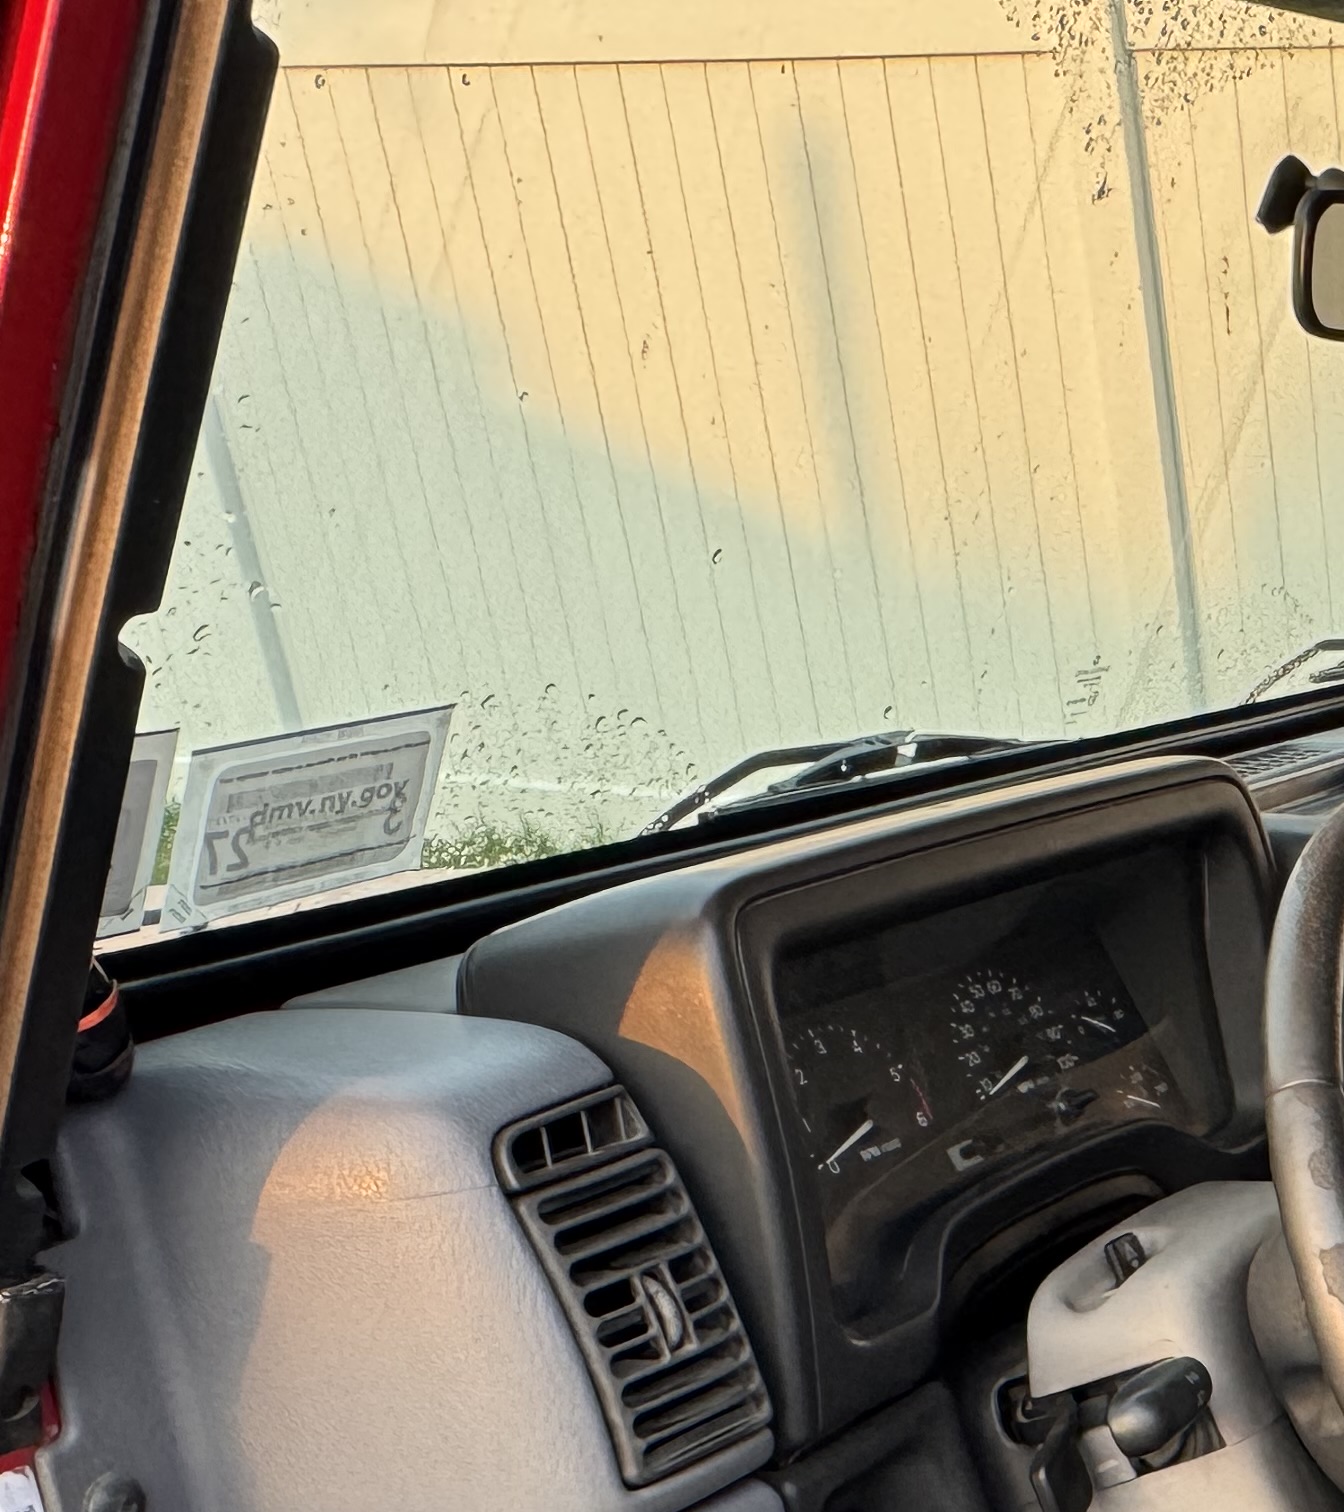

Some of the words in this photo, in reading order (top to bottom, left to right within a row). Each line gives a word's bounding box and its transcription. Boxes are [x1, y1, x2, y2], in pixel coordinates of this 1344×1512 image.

[250, 778, 411, 828] dmv.ny.gov
[794, 1068, 808, 1086] 2
[889, 1066, 901, 1082] 5
